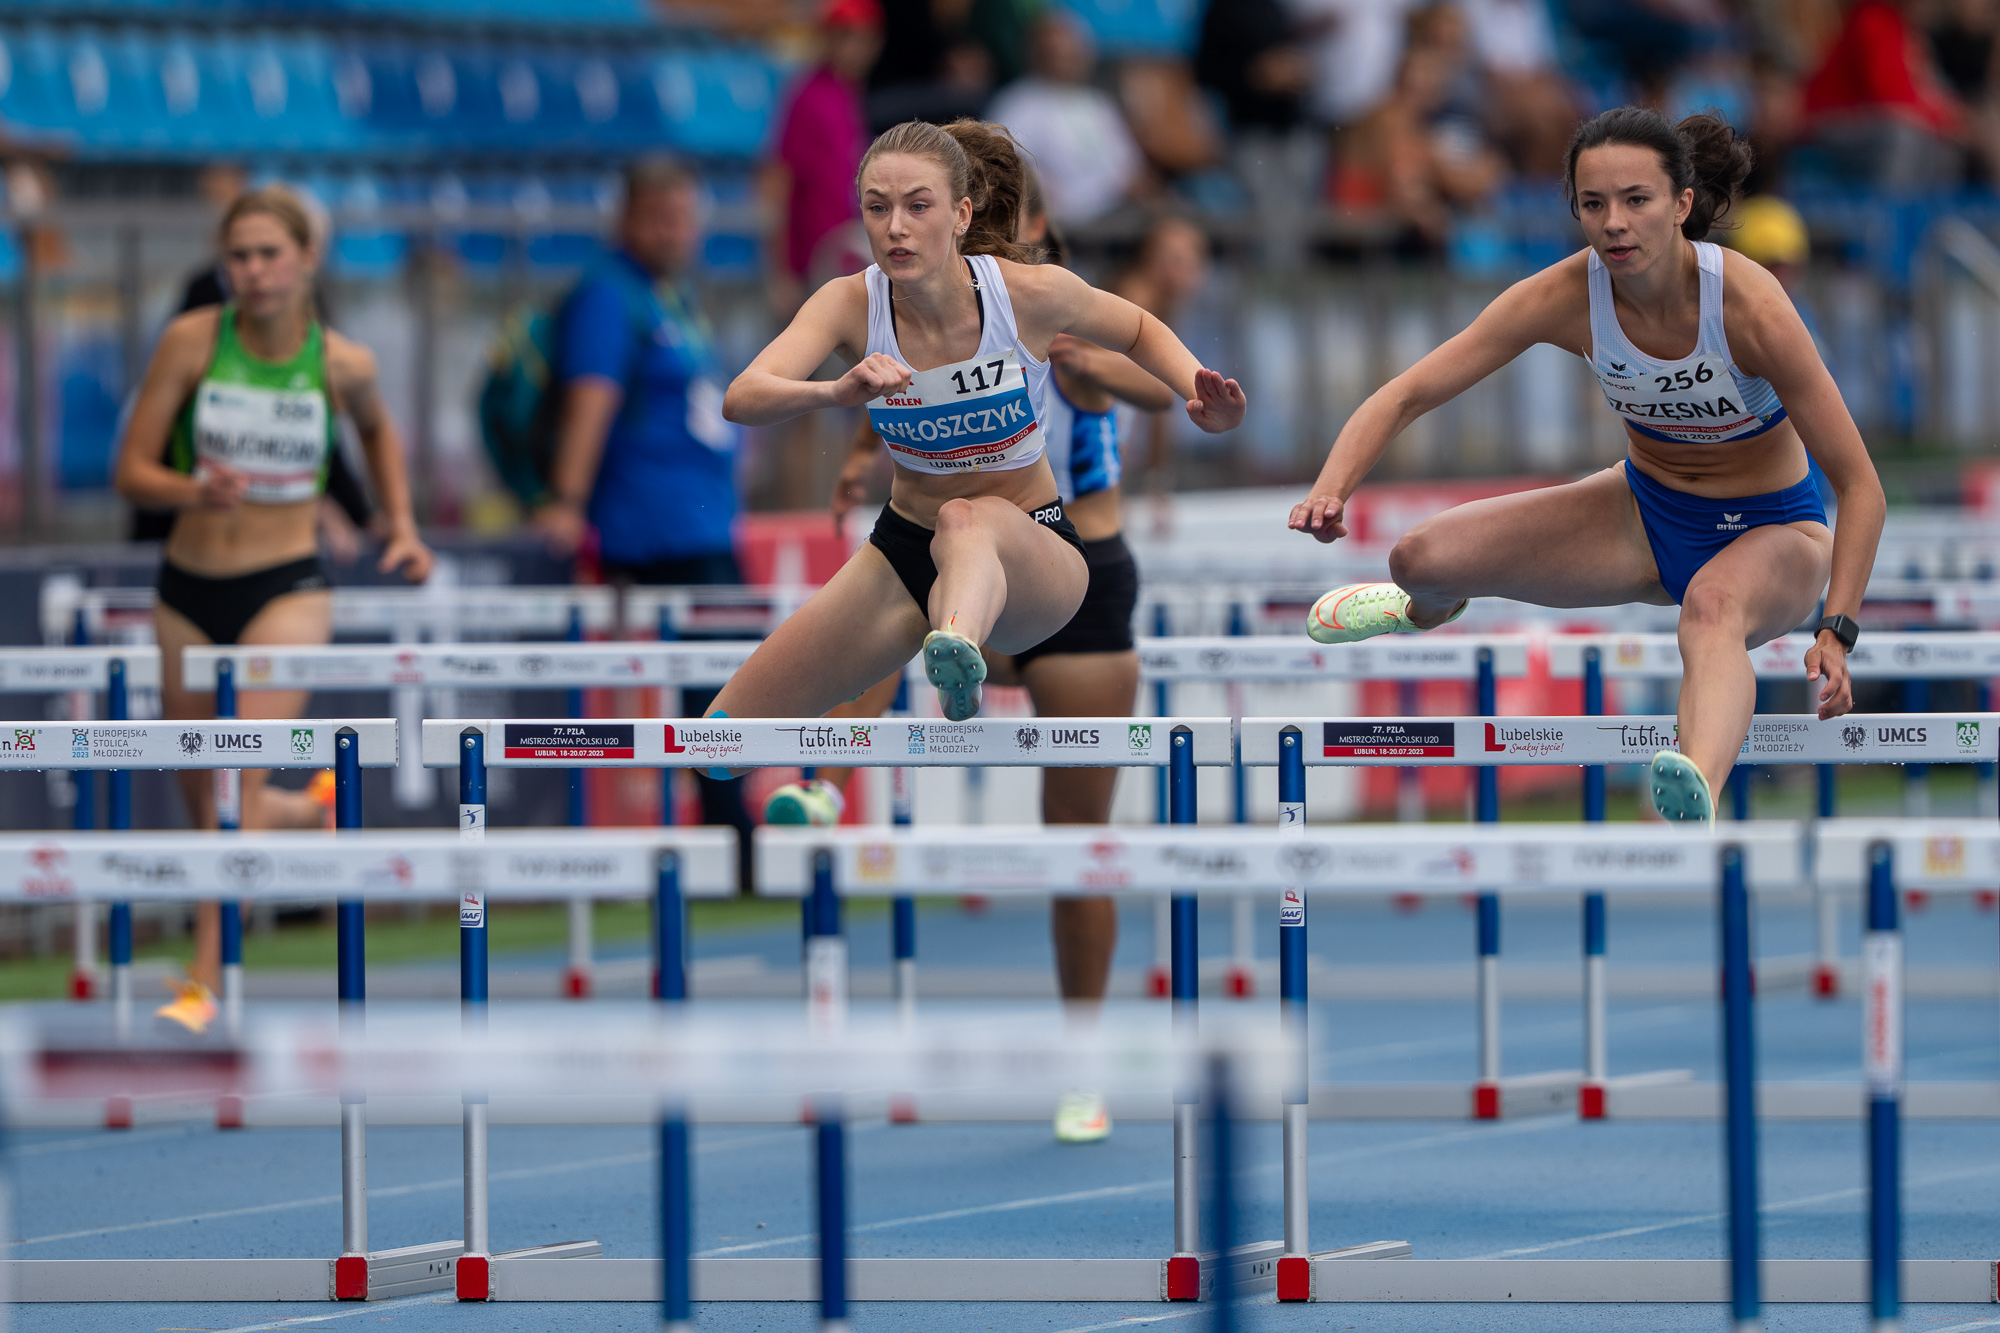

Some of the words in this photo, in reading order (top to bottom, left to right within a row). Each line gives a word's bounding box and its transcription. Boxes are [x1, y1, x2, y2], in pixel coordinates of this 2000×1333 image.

[951, 359, 1004, 394] 117
[1655, 361, 1713, 393] 256
[1603, 379, 1636, 391] SPORT
[886, 398, 922, 406] ORLEN
[878, 398, 1027, 441] WŁOSZCZYK
[932, 446, 986, 459] Mistrzostwa
[987, 440, 1012, 452] Polski
[1014, 429, 1029, 442] U20
[929, 460, 972, 468] LUBLIN
[974, 454, 1006, 465] 2023
[94, 730, 148, 738] EUROPEJSKA
[554, 728, 565, 736] 77.
[566, 728, 585, 736] PZLA
[930, 726, 984, 734] EUROPEJSKA
[1597, 725, 1670, 746] lublin
[1754, 724, 1809, 734] EUROPEJSKA
[1878, 728, 1927, 742] UMCS
[215, 734, 262, 749] UMCS
[775, 726, 847, 747] lublin
[1052, 730, 1099, 744] UMCS
[1754, 734, 1790, 742] STOLICA
[94, 748, 144, 757] MŁODZIEŻY
[689, 744, 719, 759] Smakuj
[720, 744, 743, 757] życie!
[930, 744, 980, 753] MŁODZIEŻY
[1510, 742, 1539, 757] Smakuj
[1540, 742, 1564, 756] życie!
[1754, 742, 1805, 752] MŁODZIEŻY
